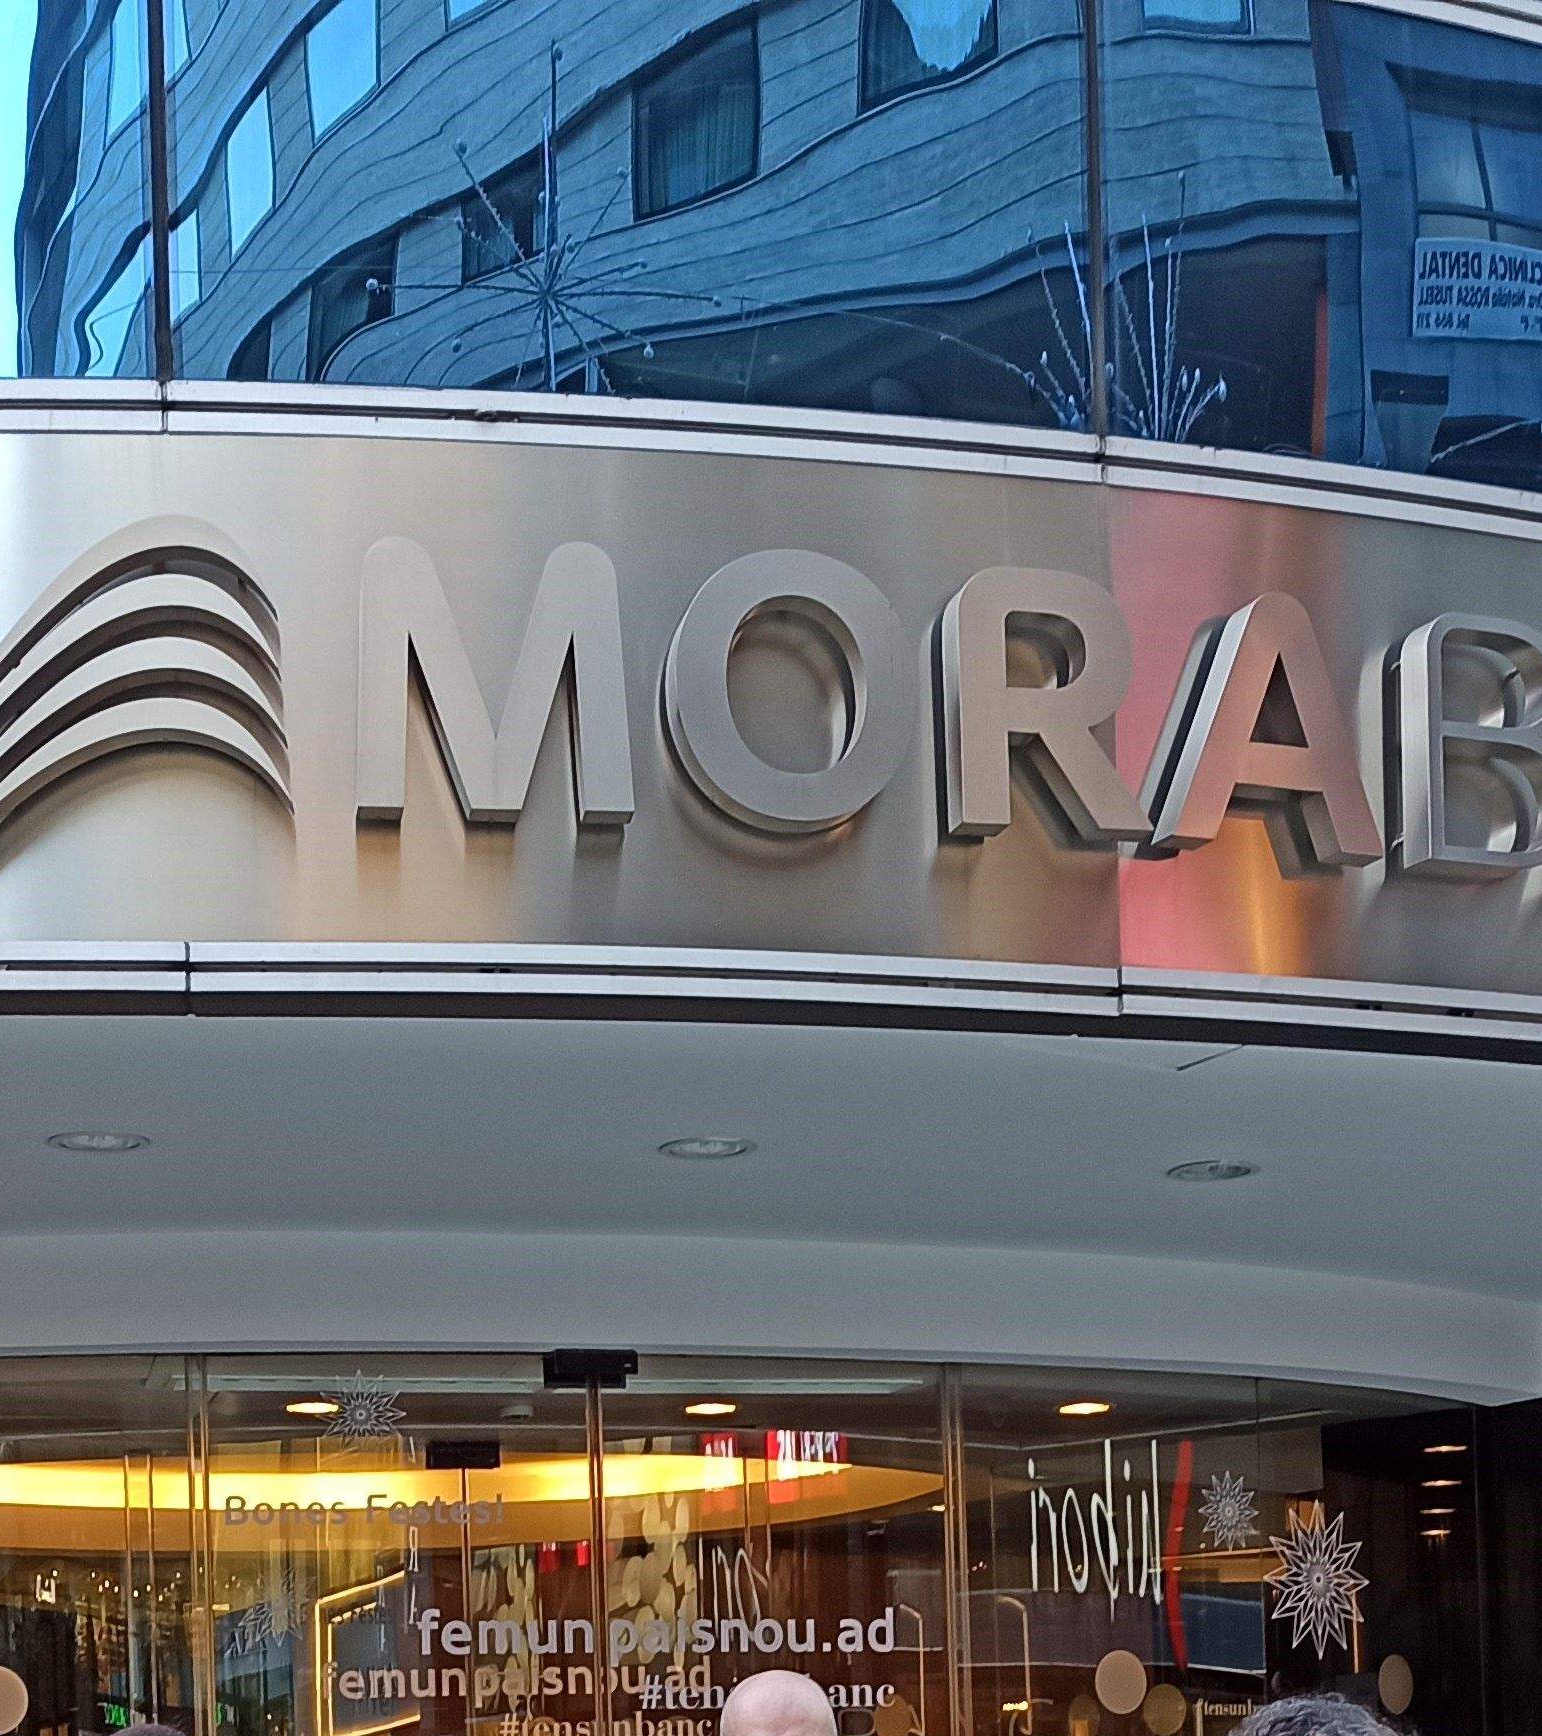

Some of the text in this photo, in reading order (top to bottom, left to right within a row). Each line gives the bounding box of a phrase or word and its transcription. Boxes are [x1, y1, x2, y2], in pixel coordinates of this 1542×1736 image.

[225, 1493, 504, 1526] Bones Festes!
[416, 1607, 894, 1668] femunpaisnou.ad
[322, 1654, 712, 1709] femunpaisnouad
